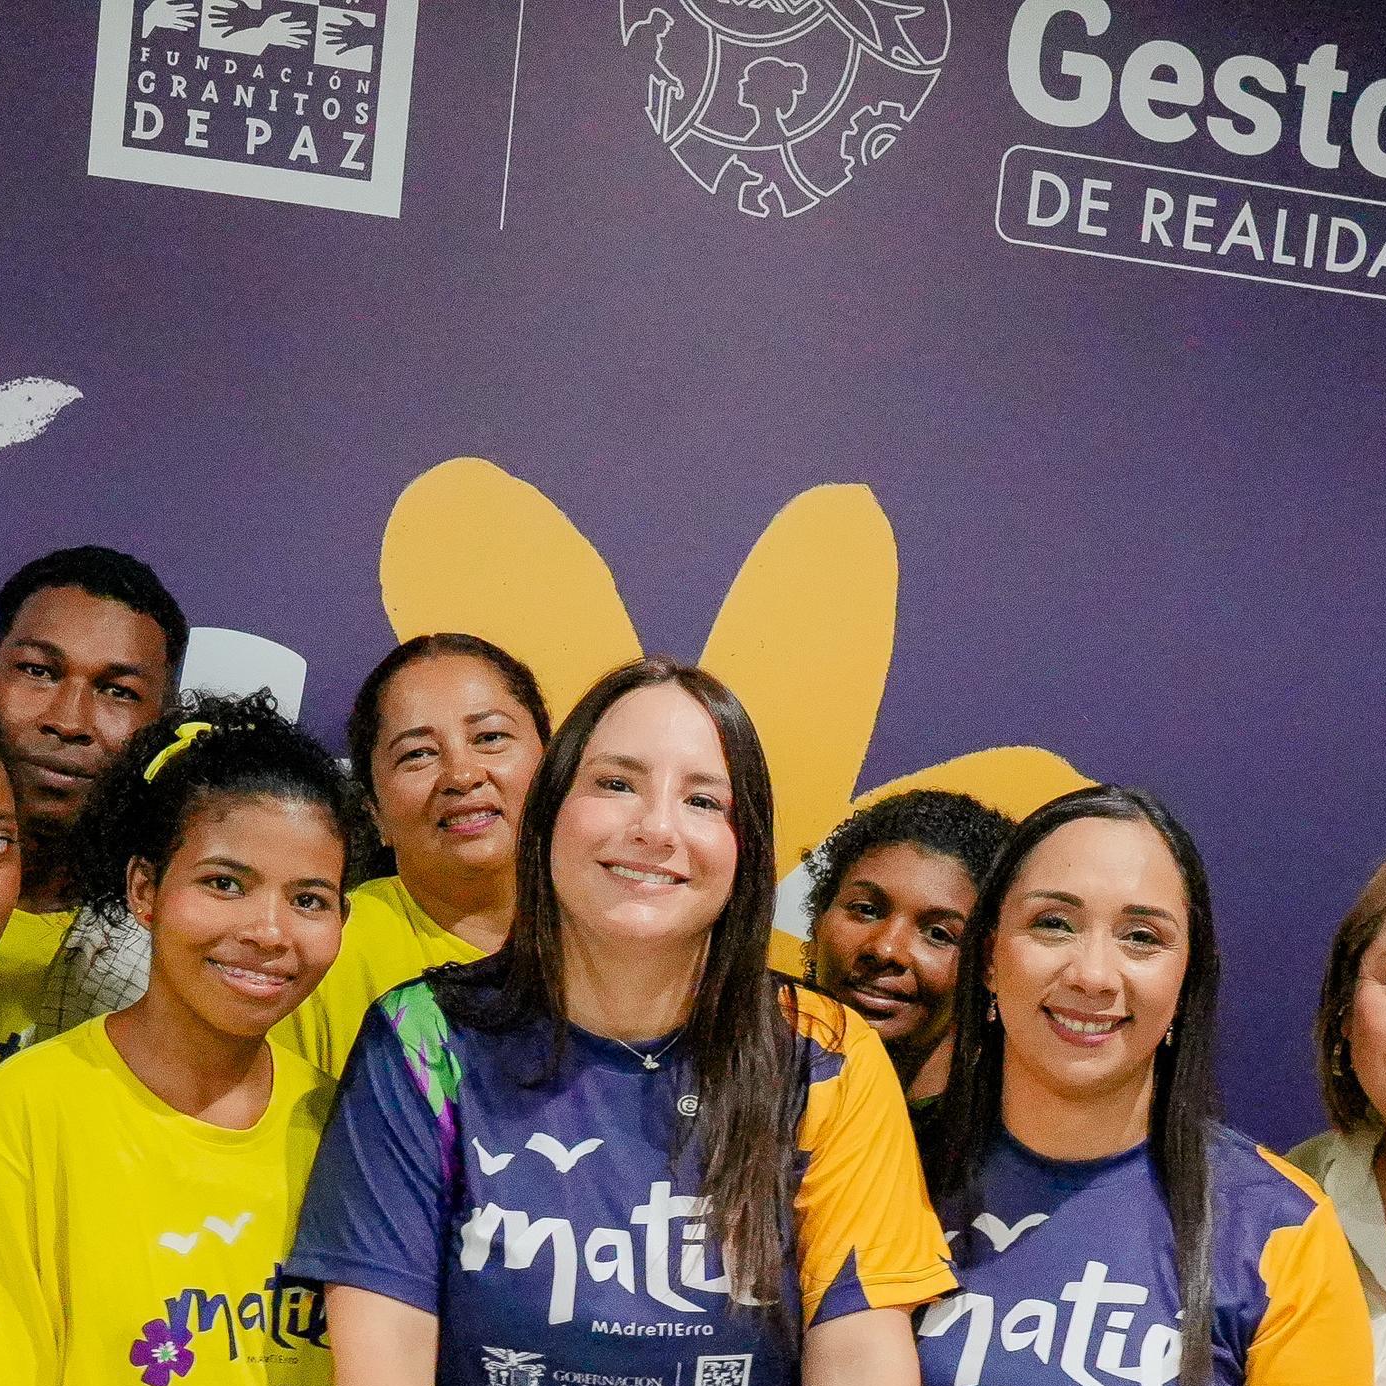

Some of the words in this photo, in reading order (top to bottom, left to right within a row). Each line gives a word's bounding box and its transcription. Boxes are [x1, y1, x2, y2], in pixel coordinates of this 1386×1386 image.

[138, 70, 370, 125] GRANITOS
[140, 47, 370, 95] FUNDACIÓN
[131, 101, 211, 149] DE
[245, 117, 365, 171] PAZ
[1027, 171, 1109, 236] DE
